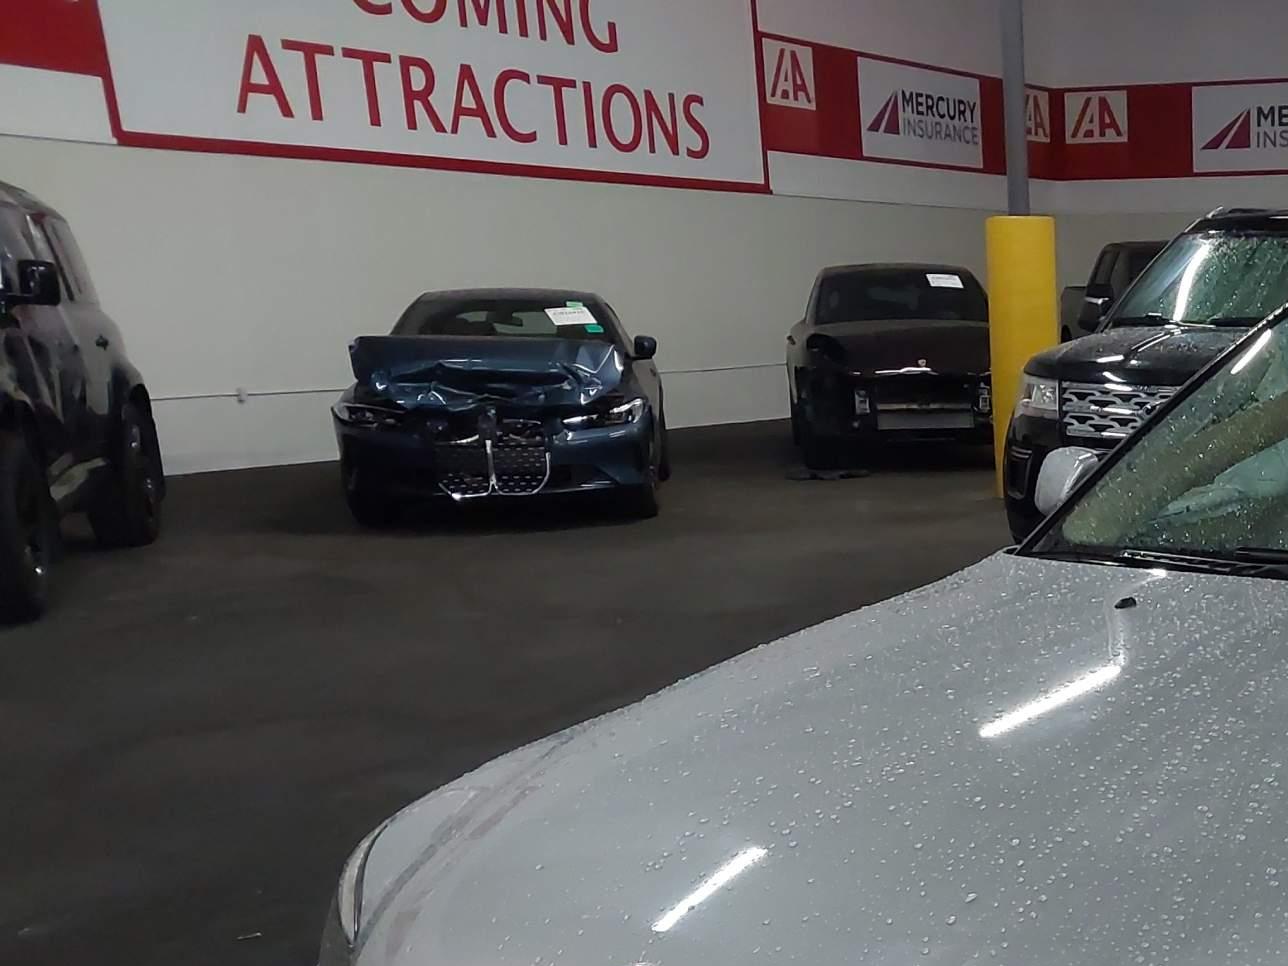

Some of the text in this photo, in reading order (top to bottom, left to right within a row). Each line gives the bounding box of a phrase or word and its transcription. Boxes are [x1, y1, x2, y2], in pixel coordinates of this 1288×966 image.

[352, 0, 618, 53] MING
[237, 34, 710, 160] ATTRACTIONS
[901, 89, 976, 121] MERCURY
[900, 118, 979, 146] INSURANCE
